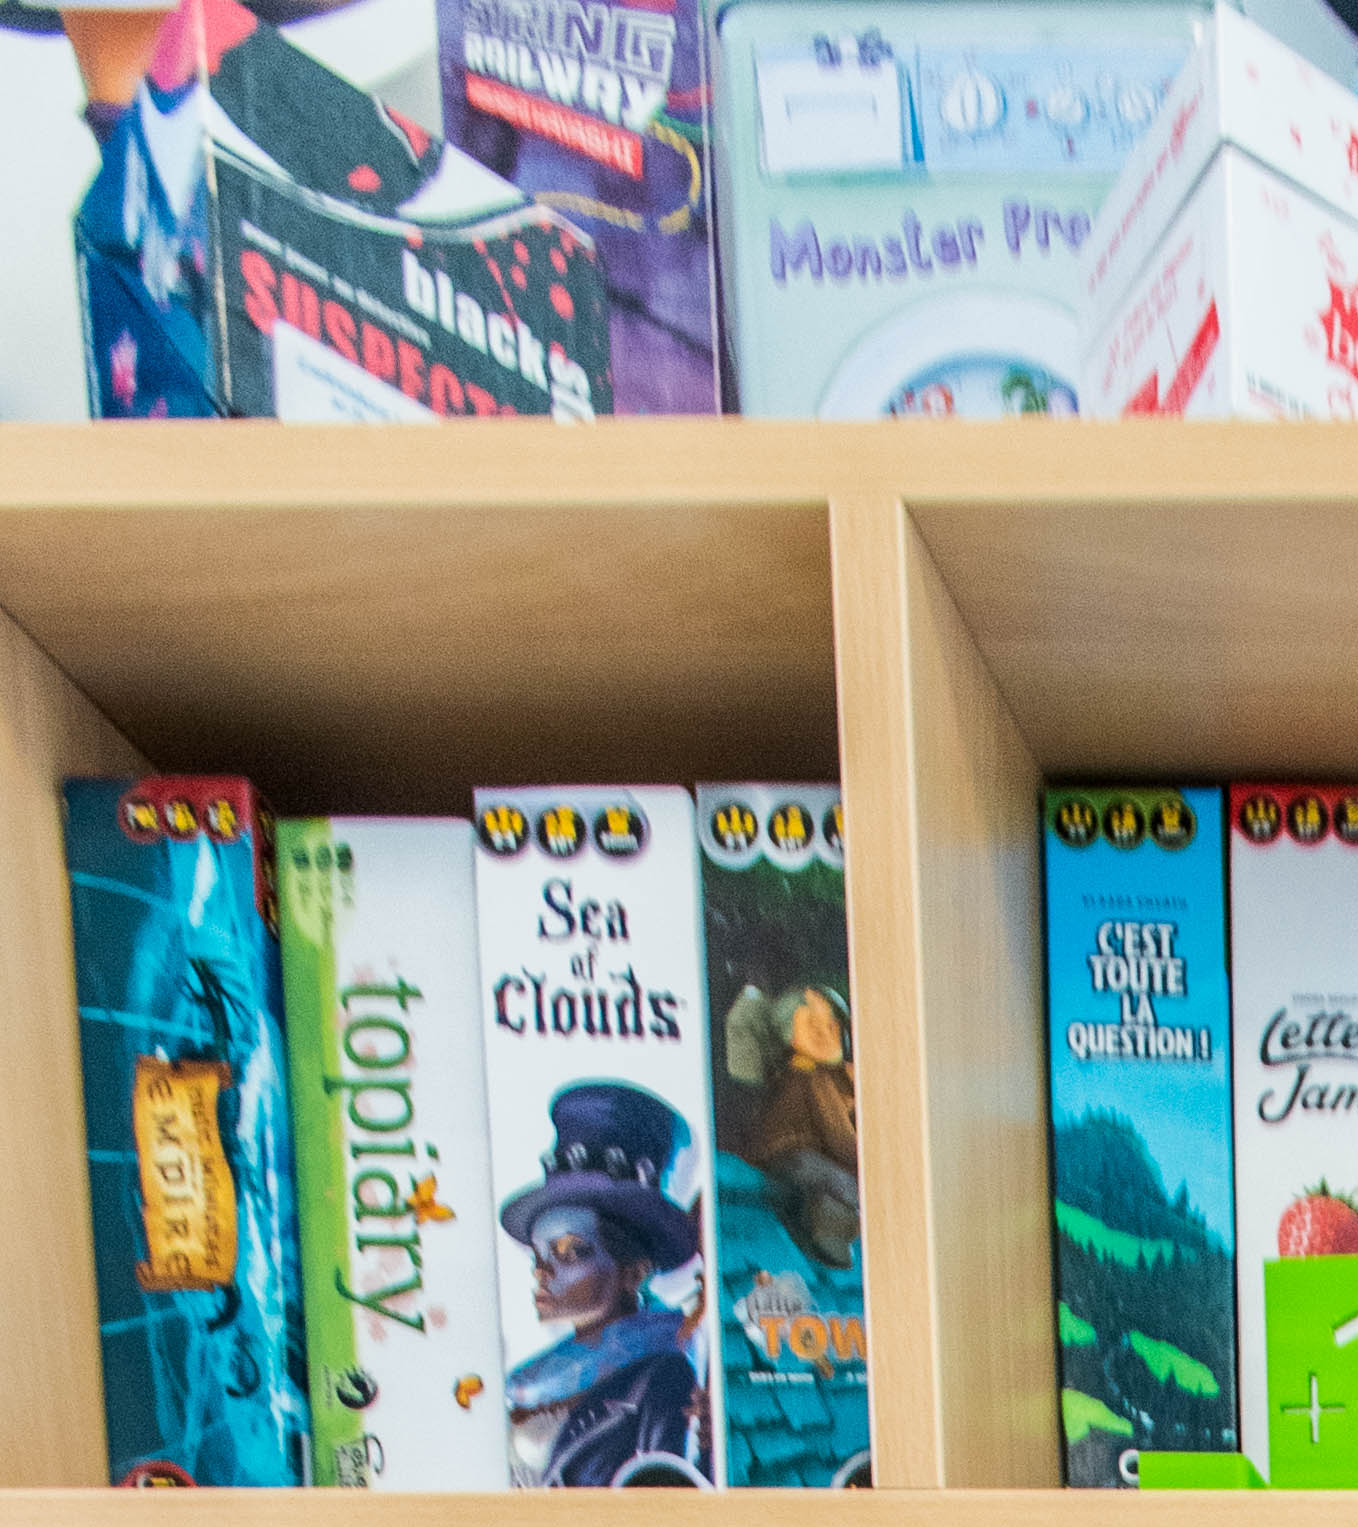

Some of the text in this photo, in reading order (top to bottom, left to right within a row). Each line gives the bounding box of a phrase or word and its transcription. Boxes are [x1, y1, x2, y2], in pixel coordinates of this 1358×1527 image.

[464, 32, 667, 133] RAILWAY
[769, 212, 986, 284] Monster
[537, 877, 630, 942] Sea
[570, 948, 602, 981] of
[1097, 920, 1178, 957] C'EST
[1087, 955, 1187, 996] TOUTE
[492, 970, 686, 1042] Clouds
[1120, 991, 1156, 1027] LA
[1067, 1022, 1192, 1062] QUESTION
[327, 974, 443, 1334] topiary
